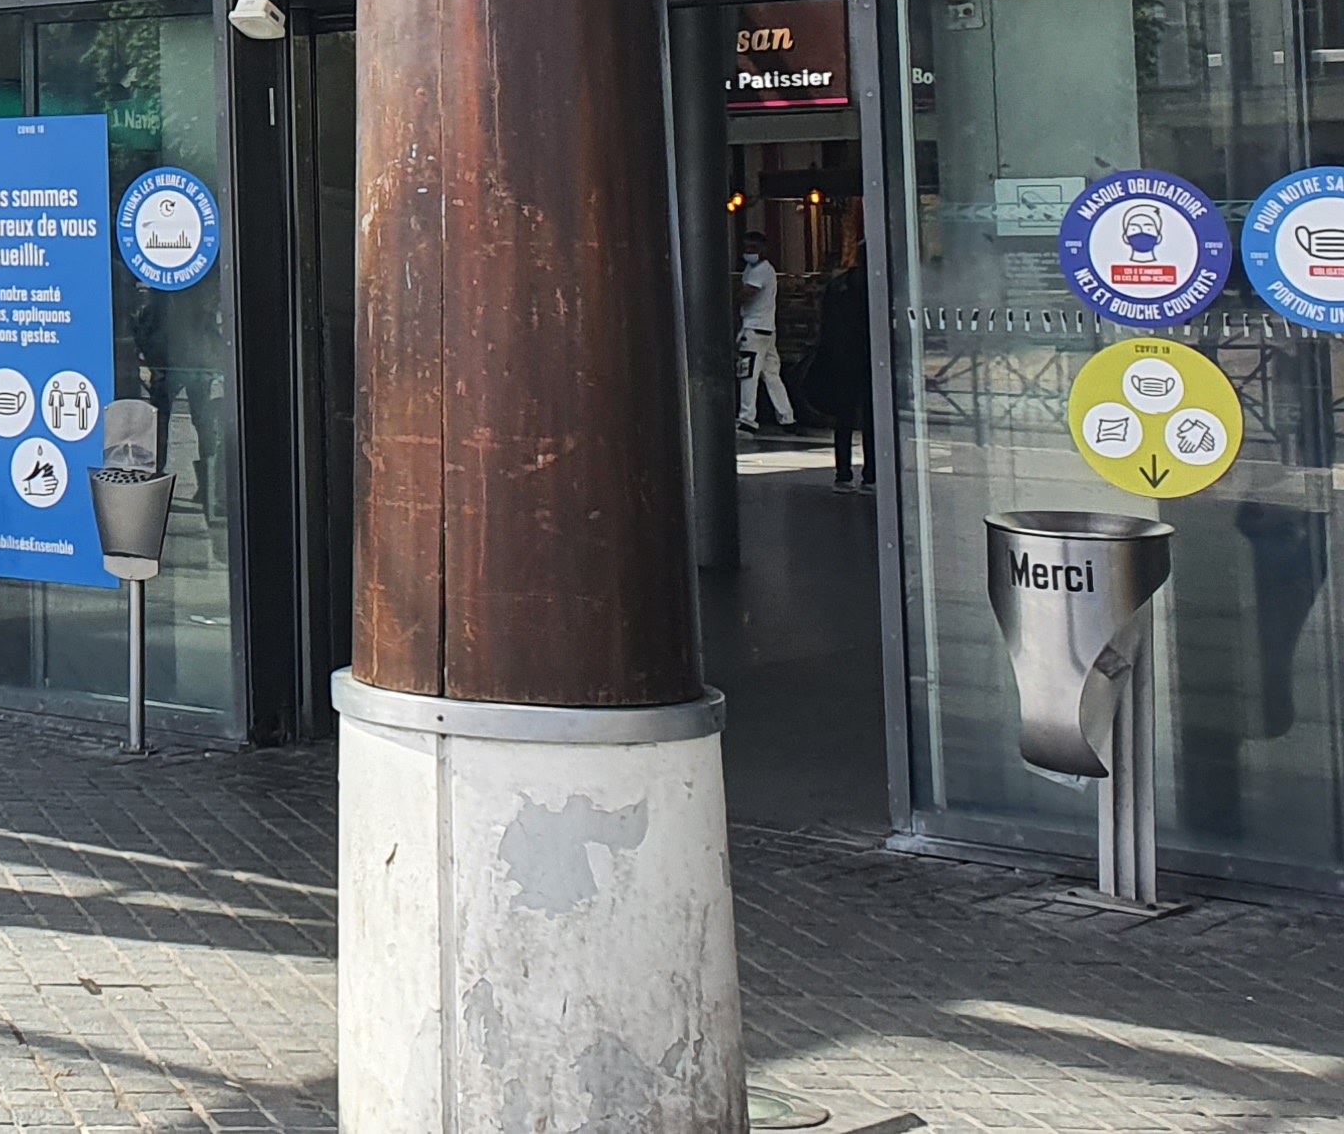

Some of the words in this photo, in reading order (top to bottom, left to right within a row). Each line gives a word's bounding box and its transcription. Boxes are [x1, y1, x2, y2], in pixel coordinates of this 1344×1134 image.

[738, 68, 833, 90] Patissier
[11, 188, 79, 209] sommes
[120, 189, 143, 228] ÉVITONS
[139, 177, 155, 195] LES
[155, 173, 187, 190] HEURES
[185, 181, 200, 197] DE
[194, 192, 216, 227] POINTE
[1077, 180, 1126, 221] MASQUE
[1127, 177, 1209, 220] OBLIGATOIRE
[1253, 199, 1285, 233] POUR
[1277, 176, 1323, 201] NOTRE
[37, 212, 57, 238] de
[60, 218, 98, 238] vous
[139, 264, 161, 283] NOUS
[162, 271, 172, 285] LE
[0, 284, 29, 302] notre
[30, 285, 62, 303] santé
[1073, 267, 1099, 294] NEZ
[1092, 288, 1112, 306] ET
[1109, 297, 1162, 321] BOUCHE
[1163, 268, 1218, 318] COUVERTS
[1267, 280, 1327, 322] PORTONS
[12, 305, 72, 327] appliquons
[20, 326, 60, 347] gestes.
[1134, 344, 1158, 354] COVID
[1008, 549, 1095, 593] Merci
